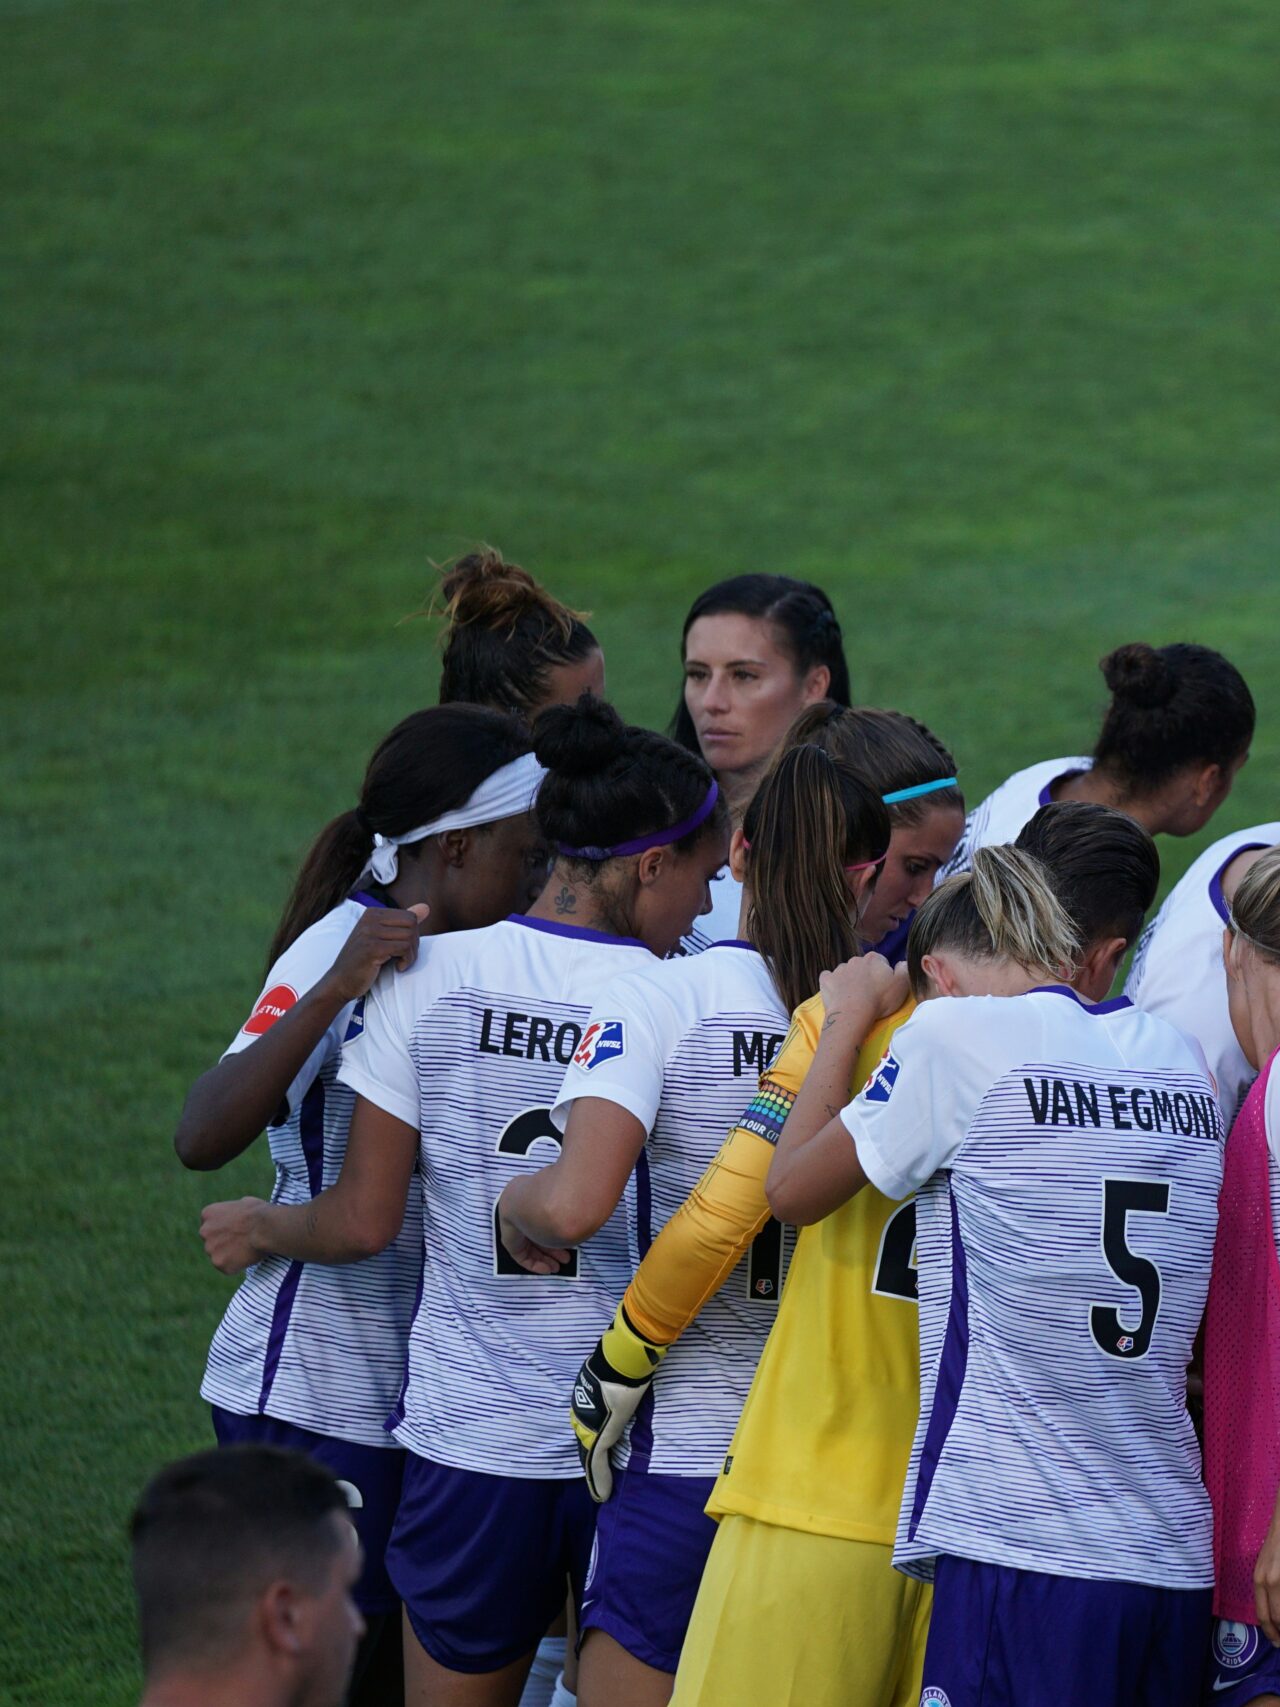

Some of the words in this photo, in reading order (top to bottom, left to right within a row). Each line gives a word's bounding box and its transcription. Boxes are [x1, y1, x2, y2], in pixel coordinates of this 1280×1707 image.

[258, 1005, 287, 1017] ETIM
[479, 1008, 582, 1065] LERO
[597, 1040, 622, 1049] NWSL
[1023, 1078, 1101, 1128] VAN
[748, 1121, 767, 1135] OUR
[766, 1129, 780, 1142] CIT
[1088, 1176, 1173, 1362] 5
[1221, 1655, 1242, 1665] PRIDE
